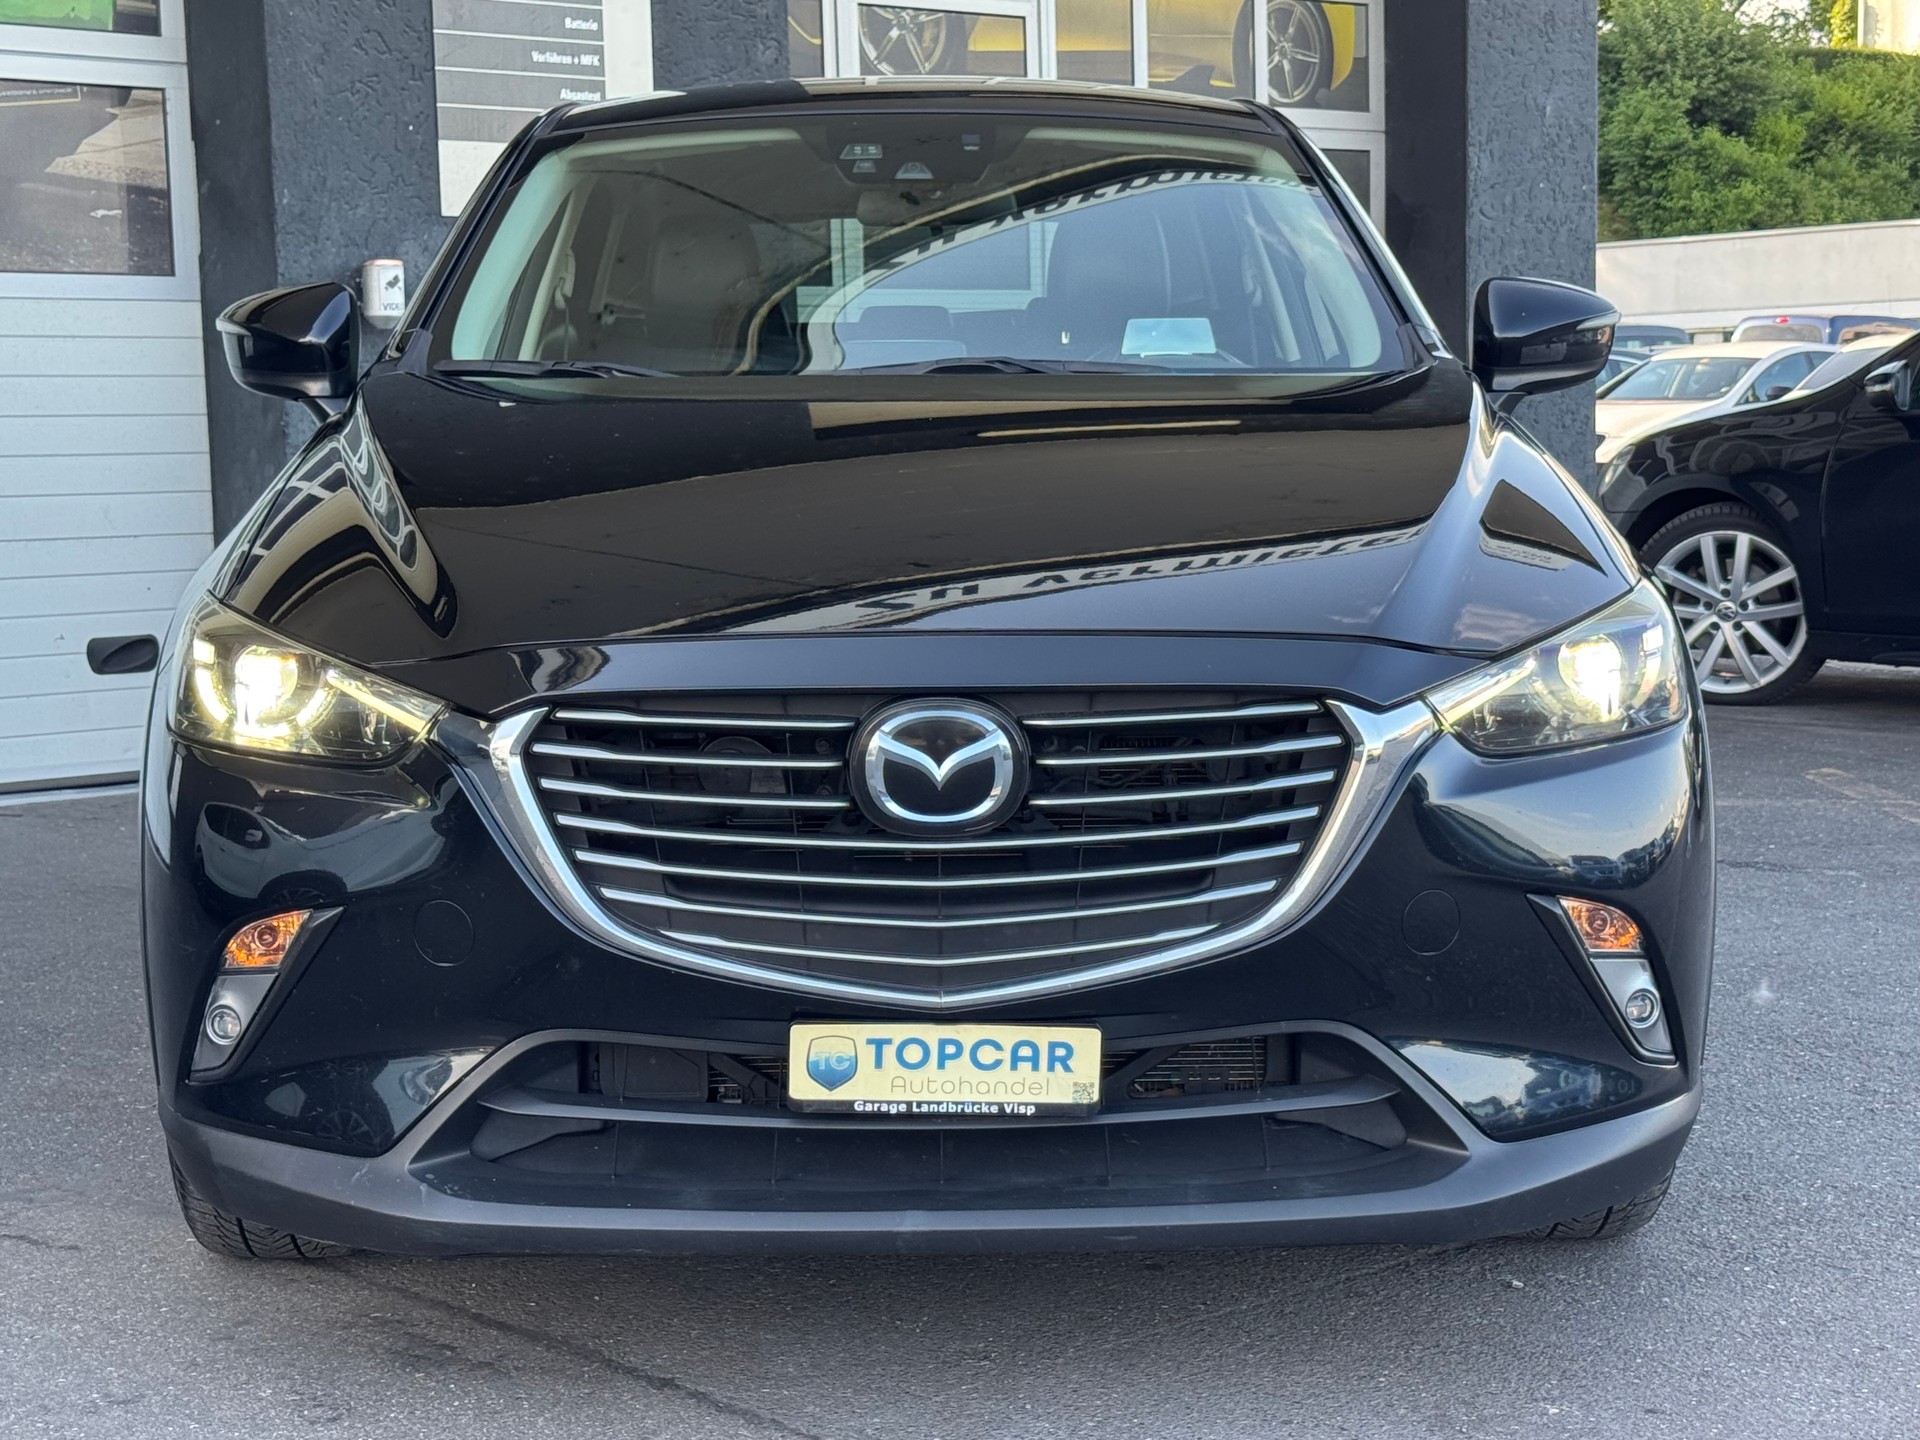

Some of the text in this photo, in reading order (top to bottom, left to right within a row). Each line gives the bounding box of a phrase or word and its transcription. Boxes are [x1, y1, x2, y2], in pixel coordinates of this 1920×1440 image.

[564, 17, 599, 31] Batterie
[814, 1051, 850, 1070] TC
[866, 1037, 1074, 1073] TOPCAR
[890, 1076, 1050, 1096] Autohandel
[853, 1100, 1036, 1115] Garage Landbrücke Visp
